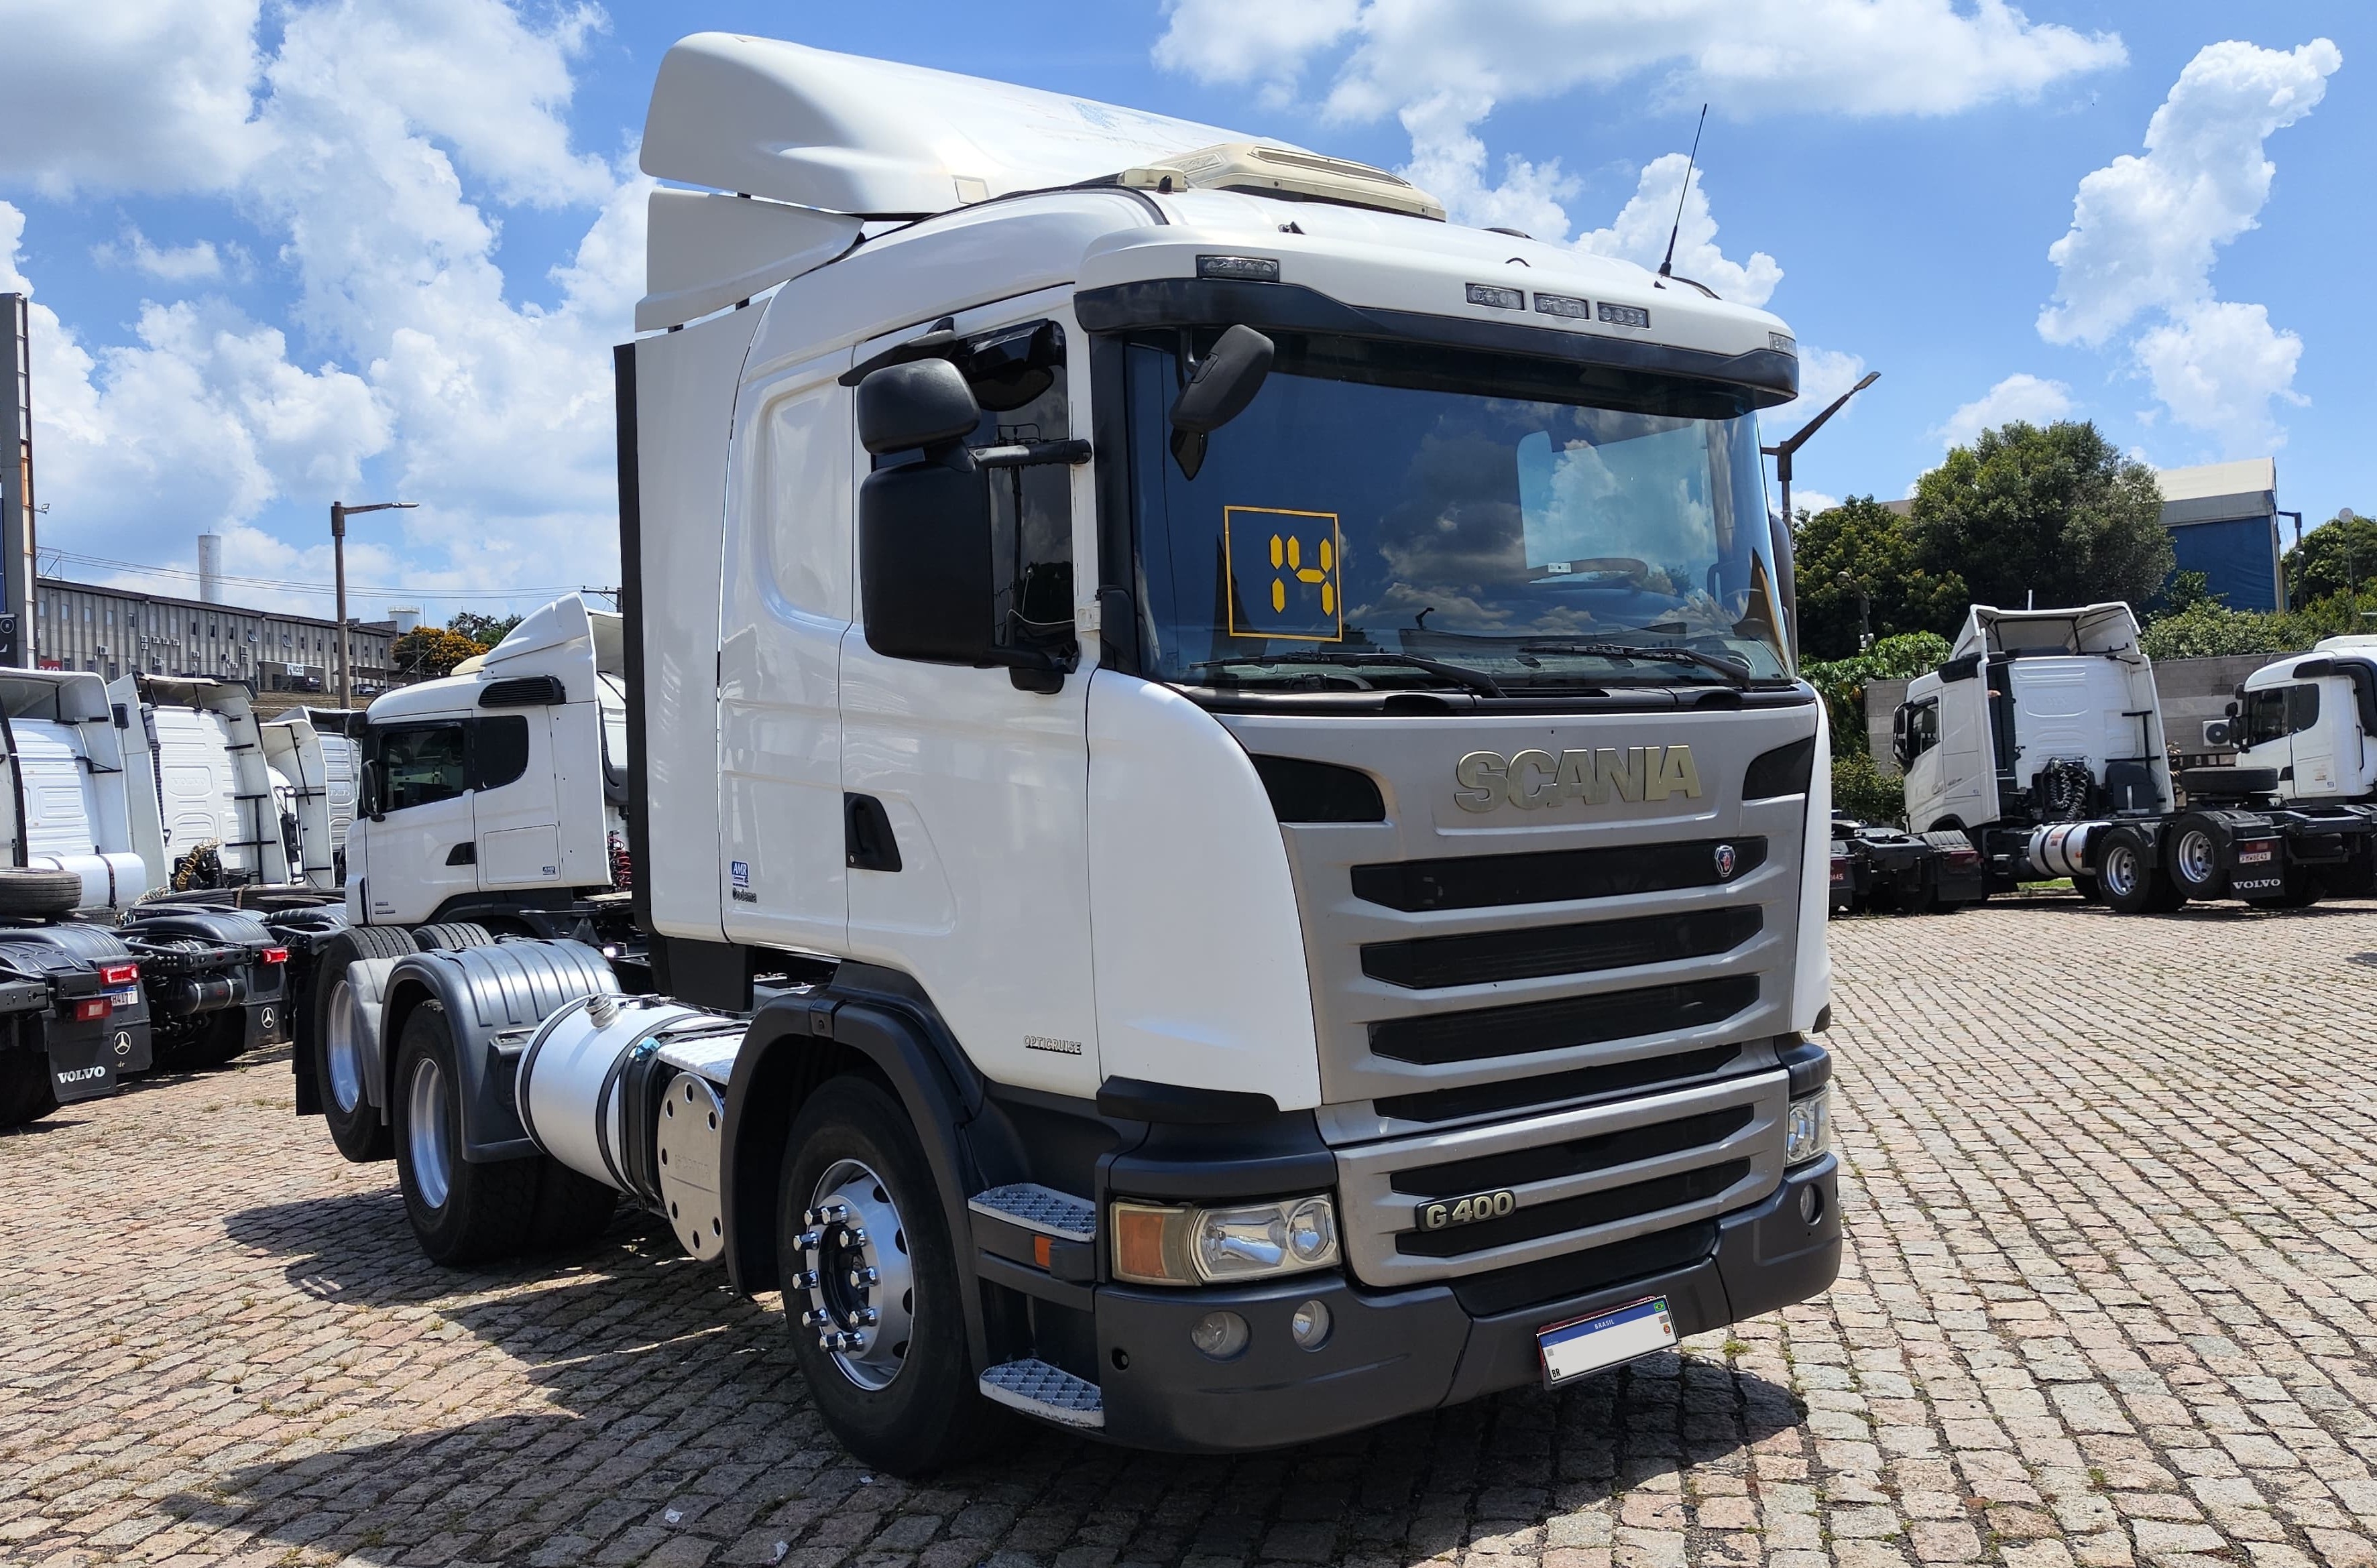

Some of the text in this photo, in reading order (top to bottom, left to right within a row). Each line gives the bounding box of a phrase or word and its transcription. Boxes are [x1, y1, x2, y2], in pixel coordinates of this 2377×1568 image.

[1269, 534, 1334, 617] 14
[1454, 744, 1702, 813] SCANIA
[733, 863, 747, 876] AMR
[2232, 878, 2281, 890] VOLVO
[732, 887, 757, 903] Codema
[1024, 1035, 1082, 1055] OPTICRUISE
[57, 1066, 106, 1083] VOLVO
[1426, 1191, 1513, 1228] G 400
[1595, 1319, 1615, 1329] BRASIL
[1551, 1368, 1561, 1378] BR
